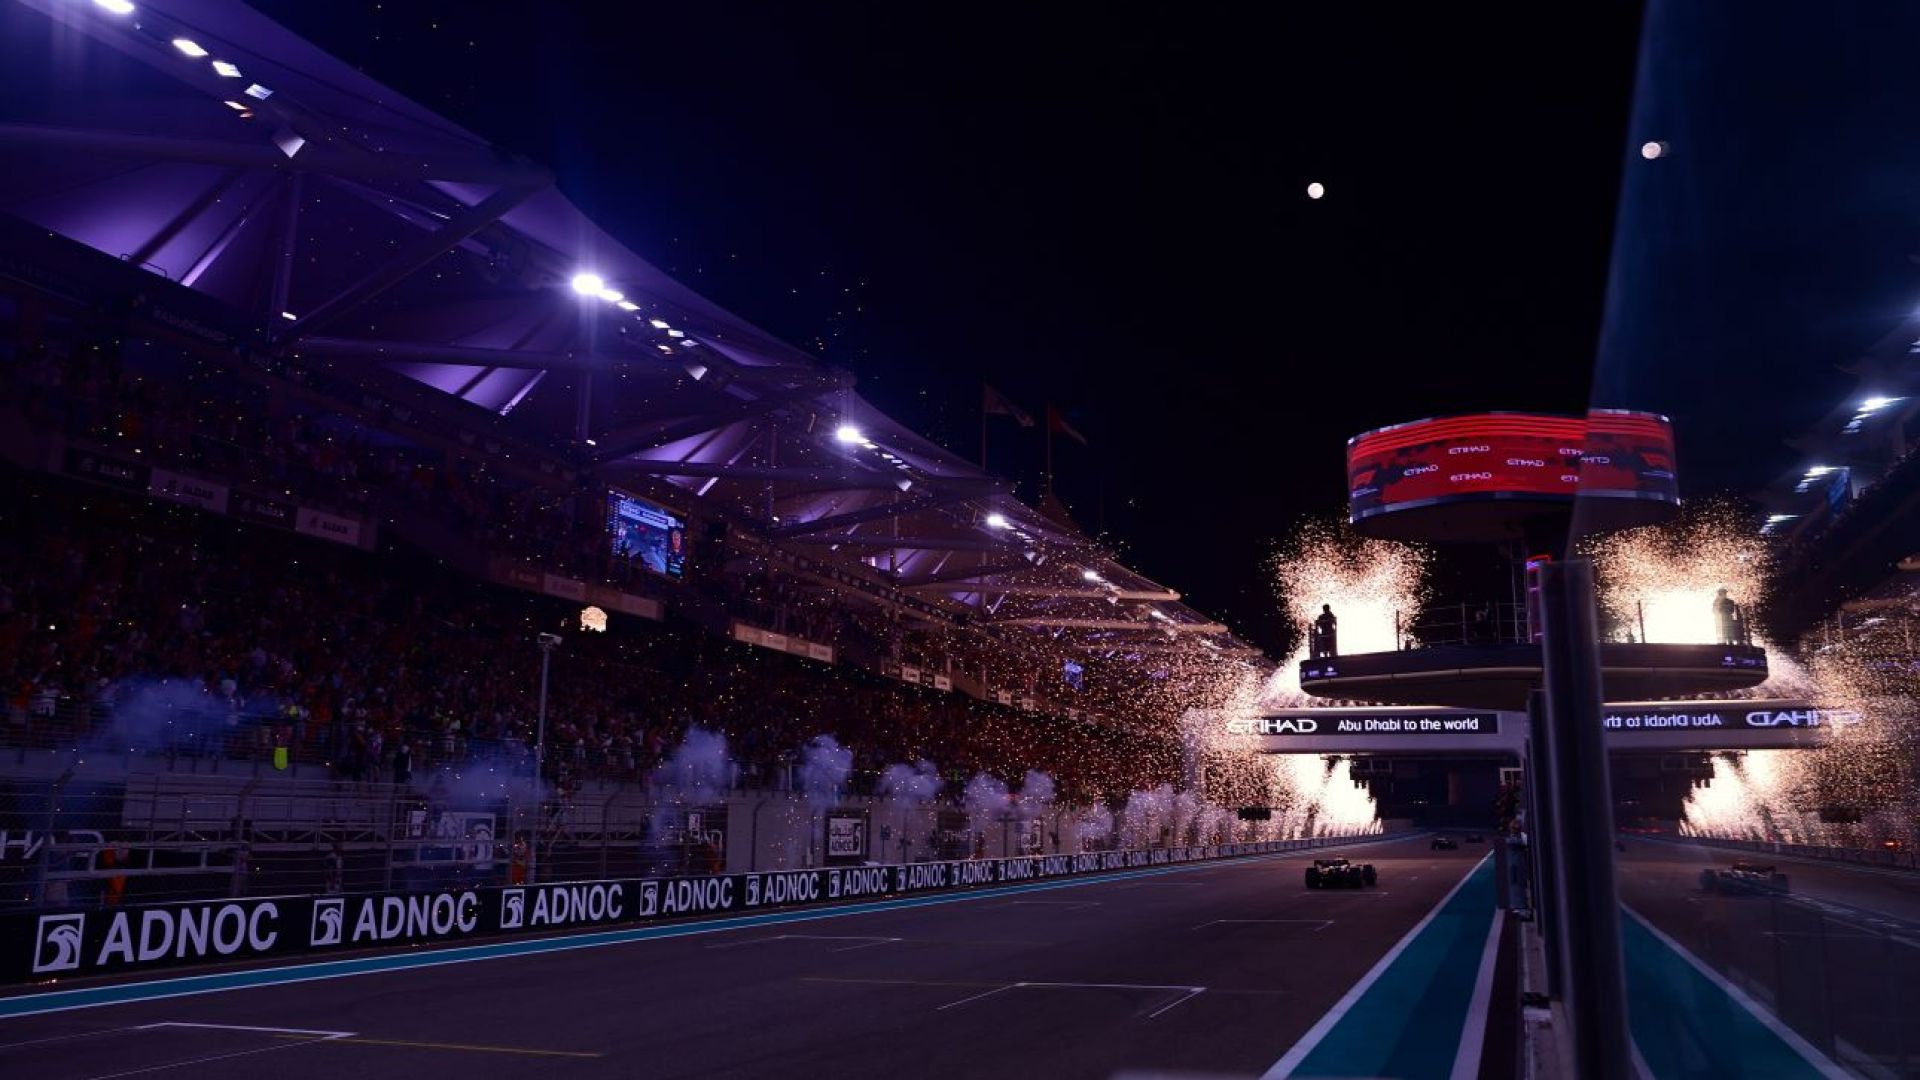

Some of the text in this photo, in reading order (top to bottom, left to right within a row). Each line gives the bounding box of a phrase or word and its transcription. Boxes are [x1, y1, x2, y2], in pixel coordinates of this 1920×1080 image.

[1448, 445, 1490, 455] ETIHAD
[1403, 464, 1438, 476] ETIHAD
[1506, 458, 1545, 467] ETIHAD
[1450, 471, 1492, 481] ETIHAD
[1338, 719, 1362, 732] Abu
[1364, 718, 1400, 731] Dhabi
[1404, 718, 1418, 730] to
[1420, 717, 1441, 730] the
[1443, 717, 1479, 730] world
[907, 864, 946, 888] ADNOC
[961, 861, 994, 884] ADNOC
[1007, 859, 1033, 878] ADNOC
[764, 871, 819, 904] ADNOC
[844, 868, 888, 895] ADNOC
[531, 884, 622, 926] ADNOC
[662, 877, 733, 913] ADNOC
[352, 892, 477, 941] ADNOC
[97, 902, 279, 965] ADNOC
